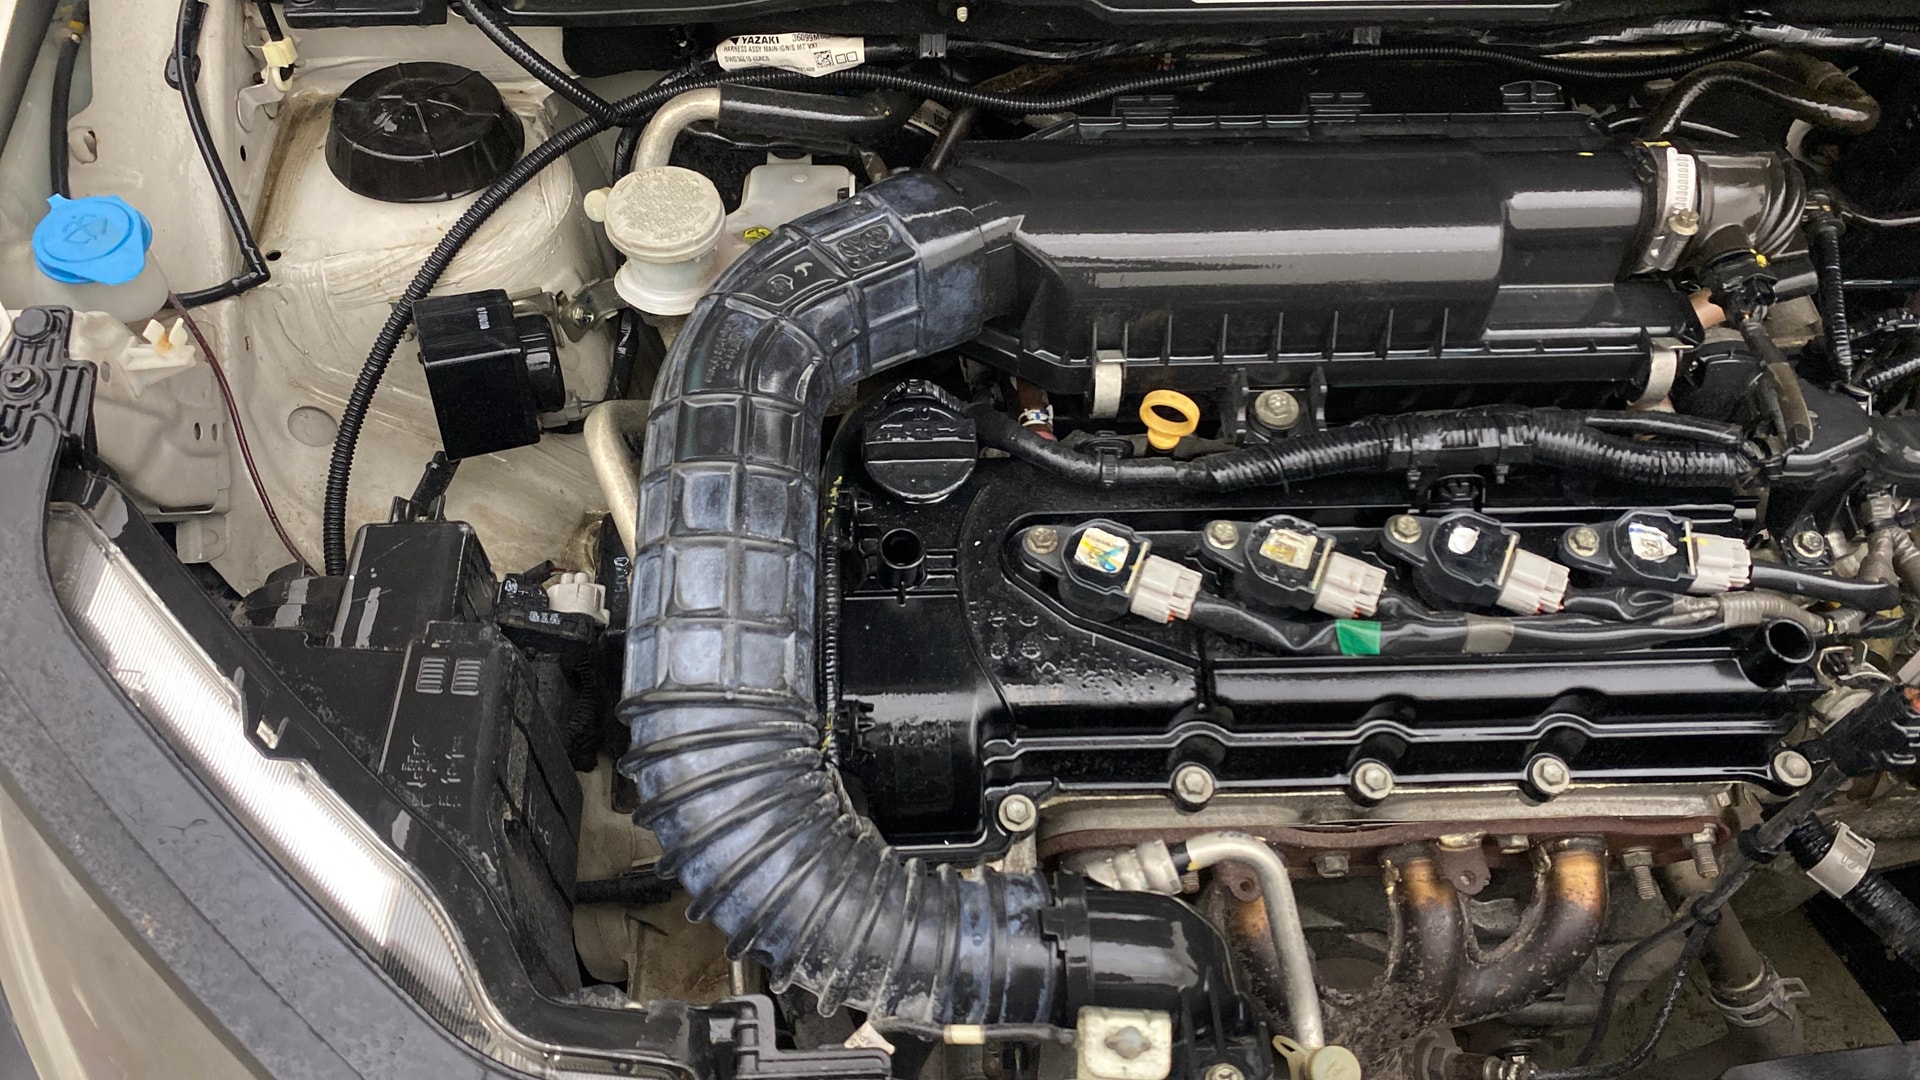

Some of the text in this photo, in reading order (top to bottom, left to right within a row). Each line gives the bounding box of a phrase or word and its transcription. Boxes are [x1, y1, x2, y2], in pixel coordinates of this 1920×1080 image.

[741, 36, 780, 45] YAZAKI
[723, 45, 747, 53] HARNESS
[748, 45, 762, 53] ASSY
